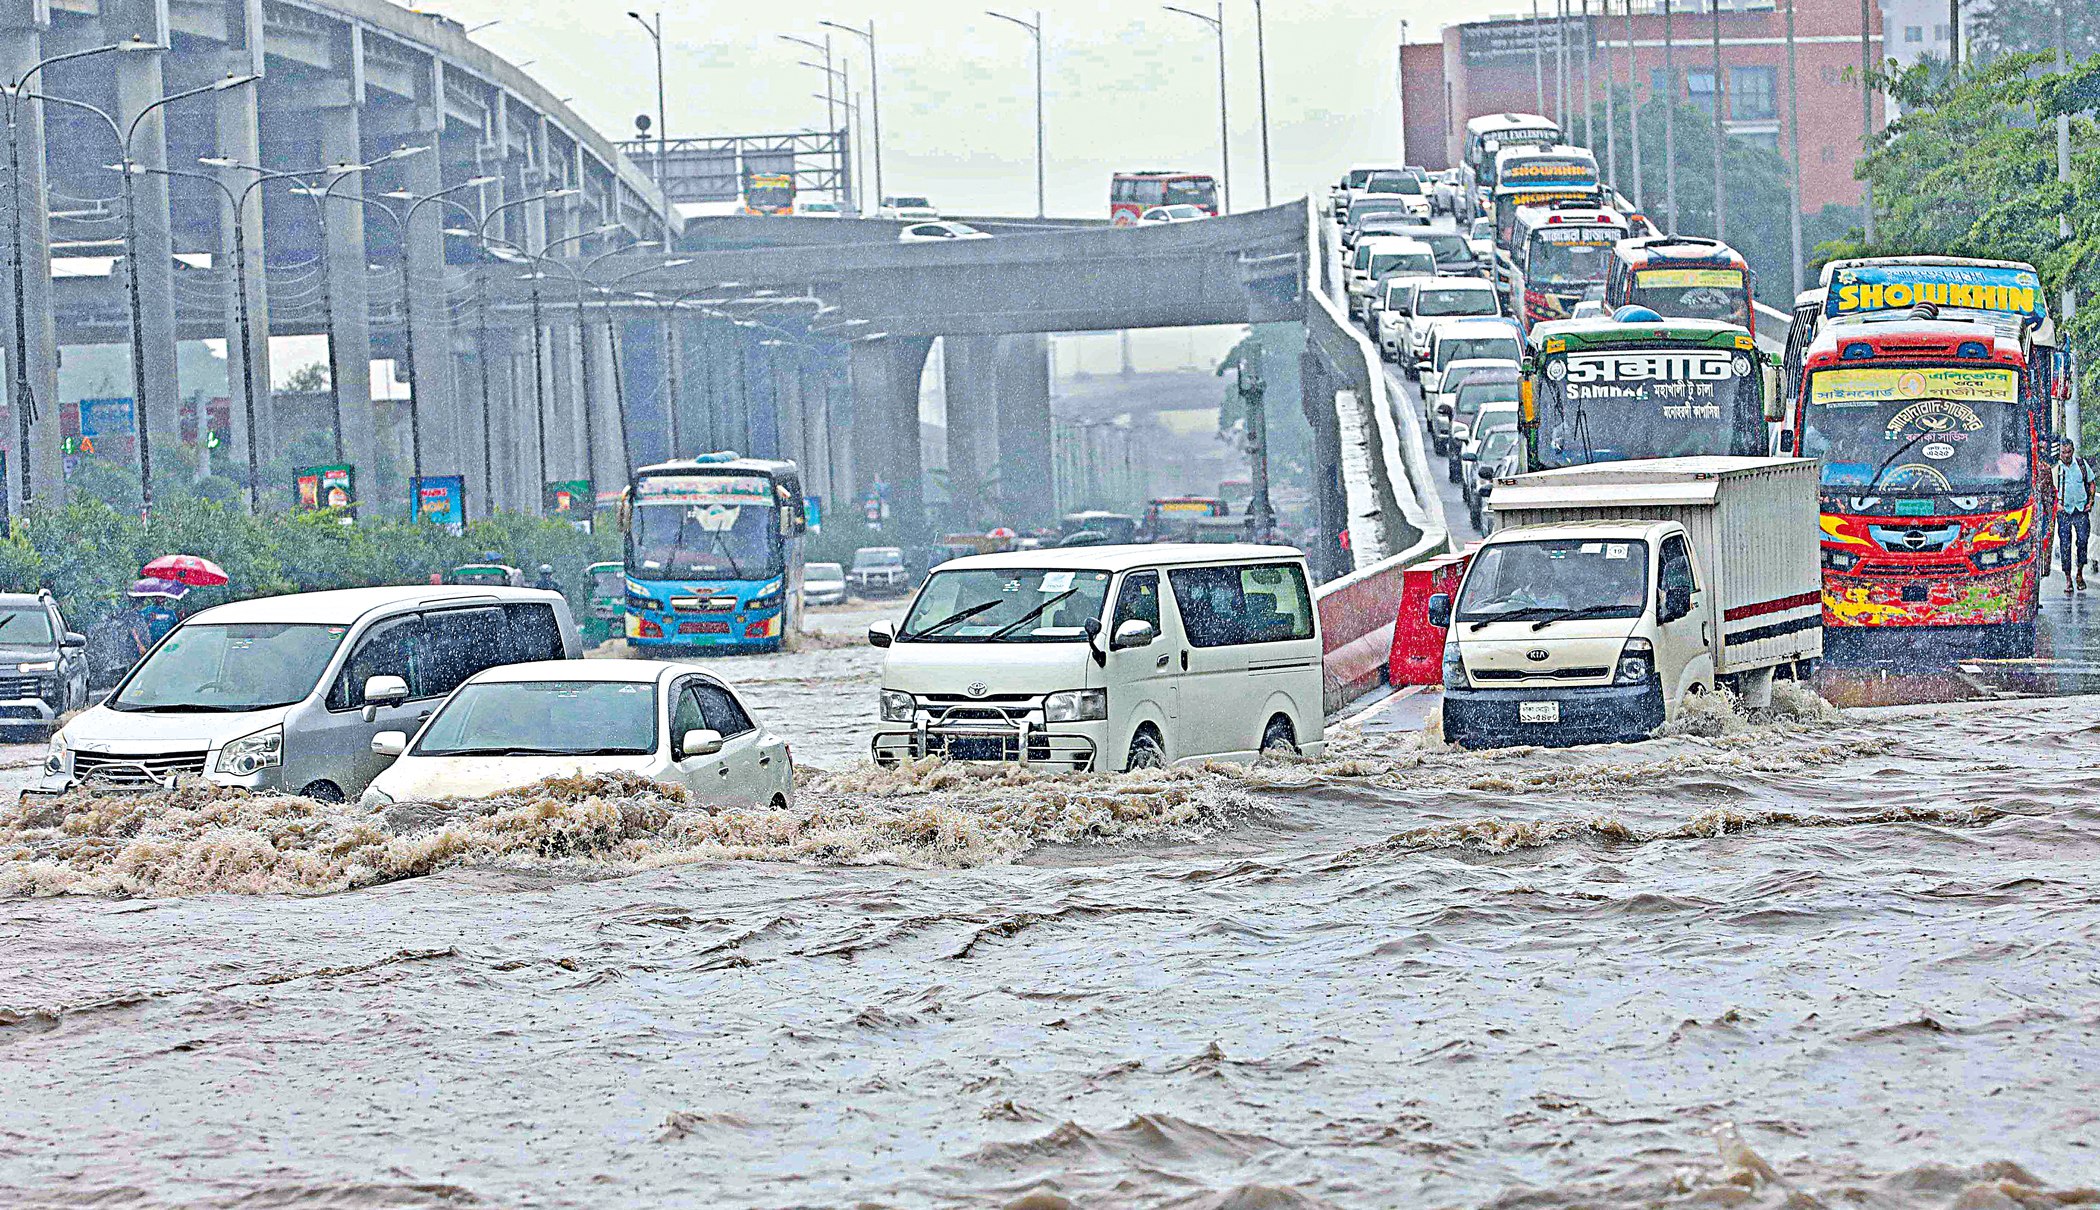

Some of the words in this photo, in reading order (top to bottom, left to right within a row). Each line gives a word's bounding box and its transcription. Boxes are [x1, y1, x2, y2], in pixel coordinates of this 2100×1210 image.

[1838, 283, 2034, 313] SHOWKHIN
[1566, 350, 1732, 383] সম্রাট
[1653, 379, 1686, 399] মহাখালী
[1687, 380, 1695, 402] টু
[1696, 382, 1714, 398] চালা
[1816, 387, 1895, 399] সাইনবোর্ড
[1530, 651, 1546, 659] KIA
